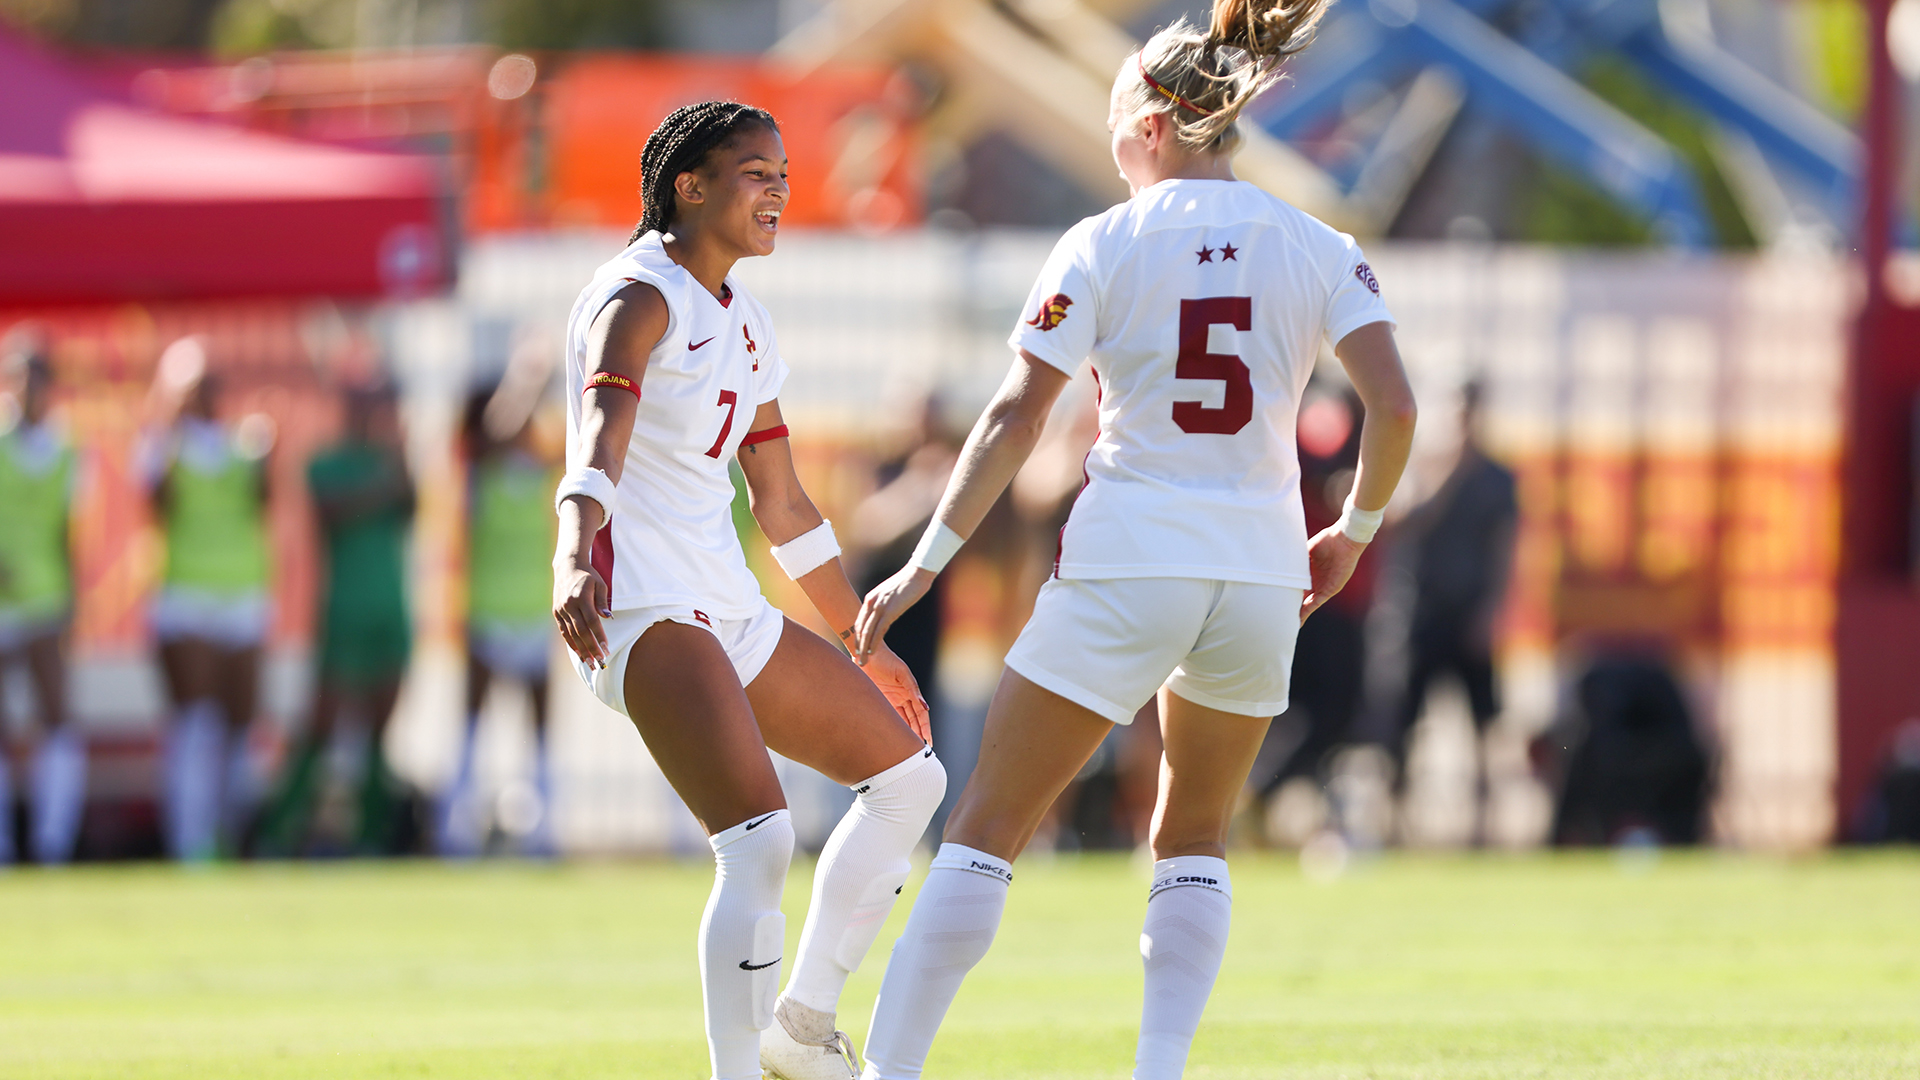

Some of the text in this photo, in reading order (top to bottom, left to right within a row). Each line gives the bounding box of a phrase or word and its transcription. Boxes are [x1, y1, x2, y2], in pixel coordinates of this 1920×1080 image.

[1172, 296, 1254, 435] 5
[593, 375, 631, 387] TROJANS
[704, 389, 737, 459] 7
[970, 860, 1006, 876] NIKE
[1176, 876, 1218, 885] GRIP
